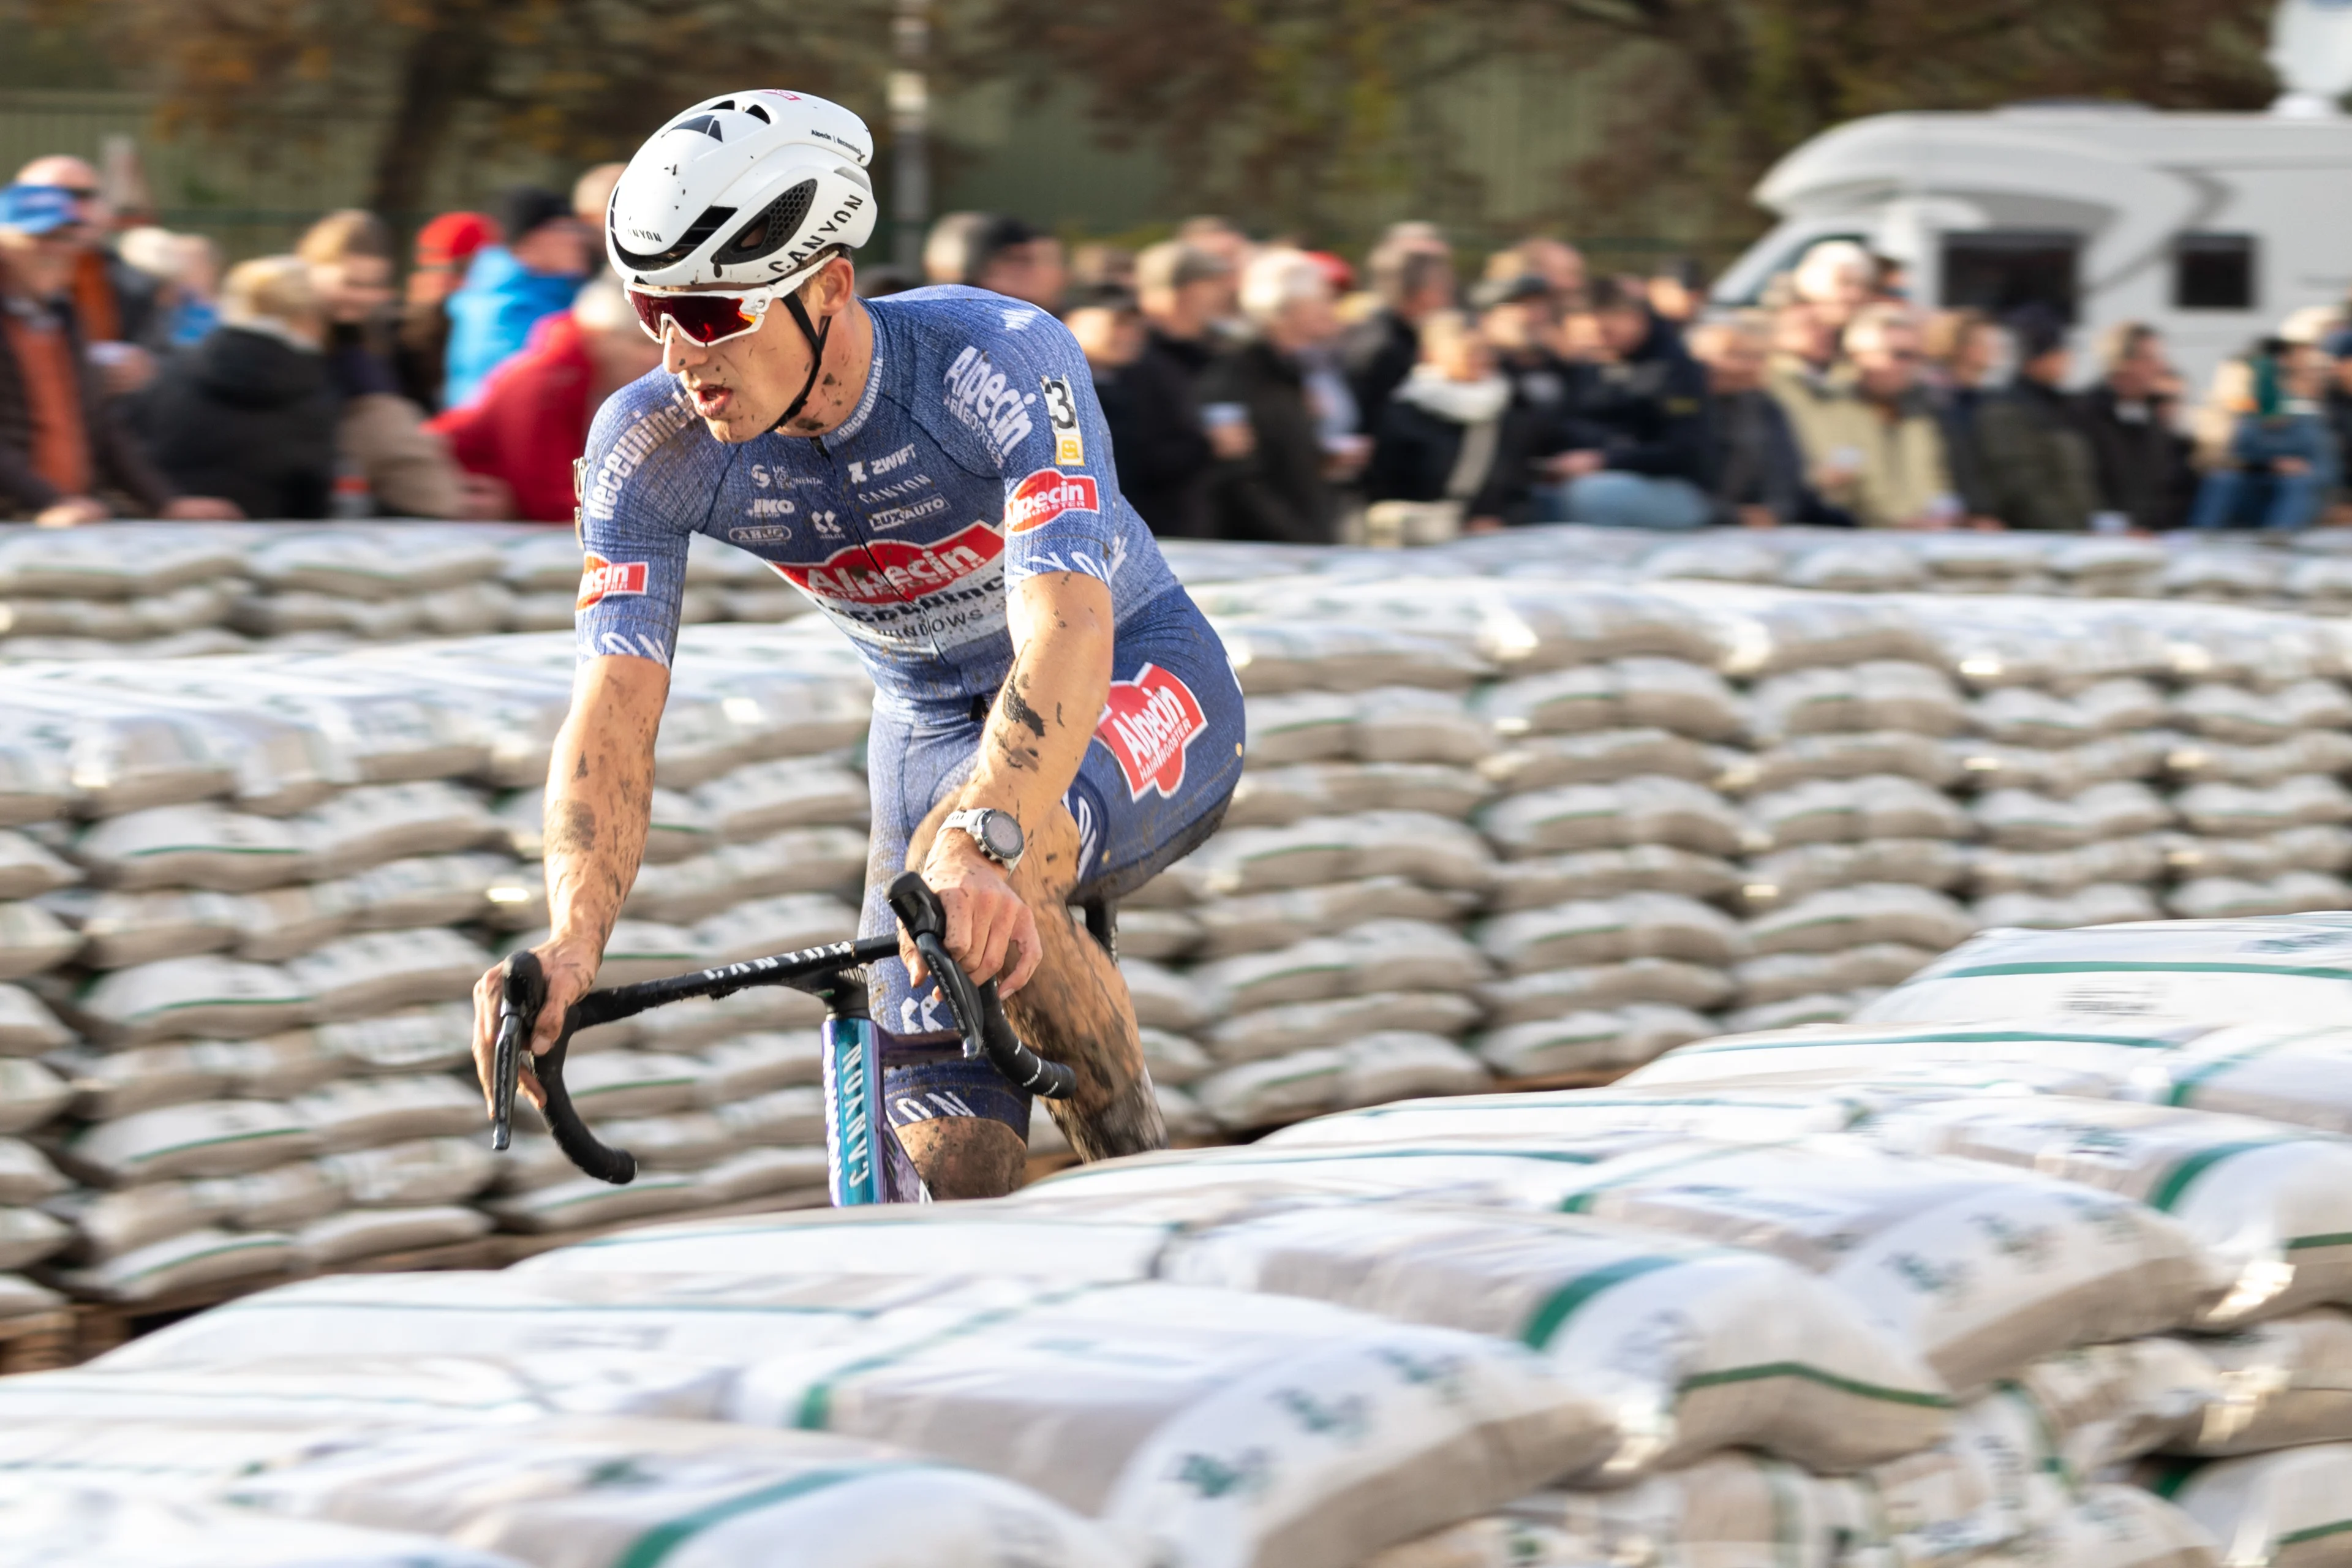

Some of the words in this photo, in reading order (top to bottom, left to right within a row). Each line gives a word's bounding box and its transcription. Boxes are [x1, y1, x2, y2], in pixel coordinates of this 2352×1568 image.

[768, 194, 864, 273] CANYON
[943, 345, 1036, 458] Alpecin
[1044, 380, 1076, 429] 3
[870, 442, 917, 475] ZWIFT
[858, 473, 932, 505] CANYON
[808, 545, 980, 598] Alpecin
[1112, 685, 1187, 769] Alpecin
[703, 941, 852, 980] CANYON
[842, 1042, 870, 1188] CANYON
